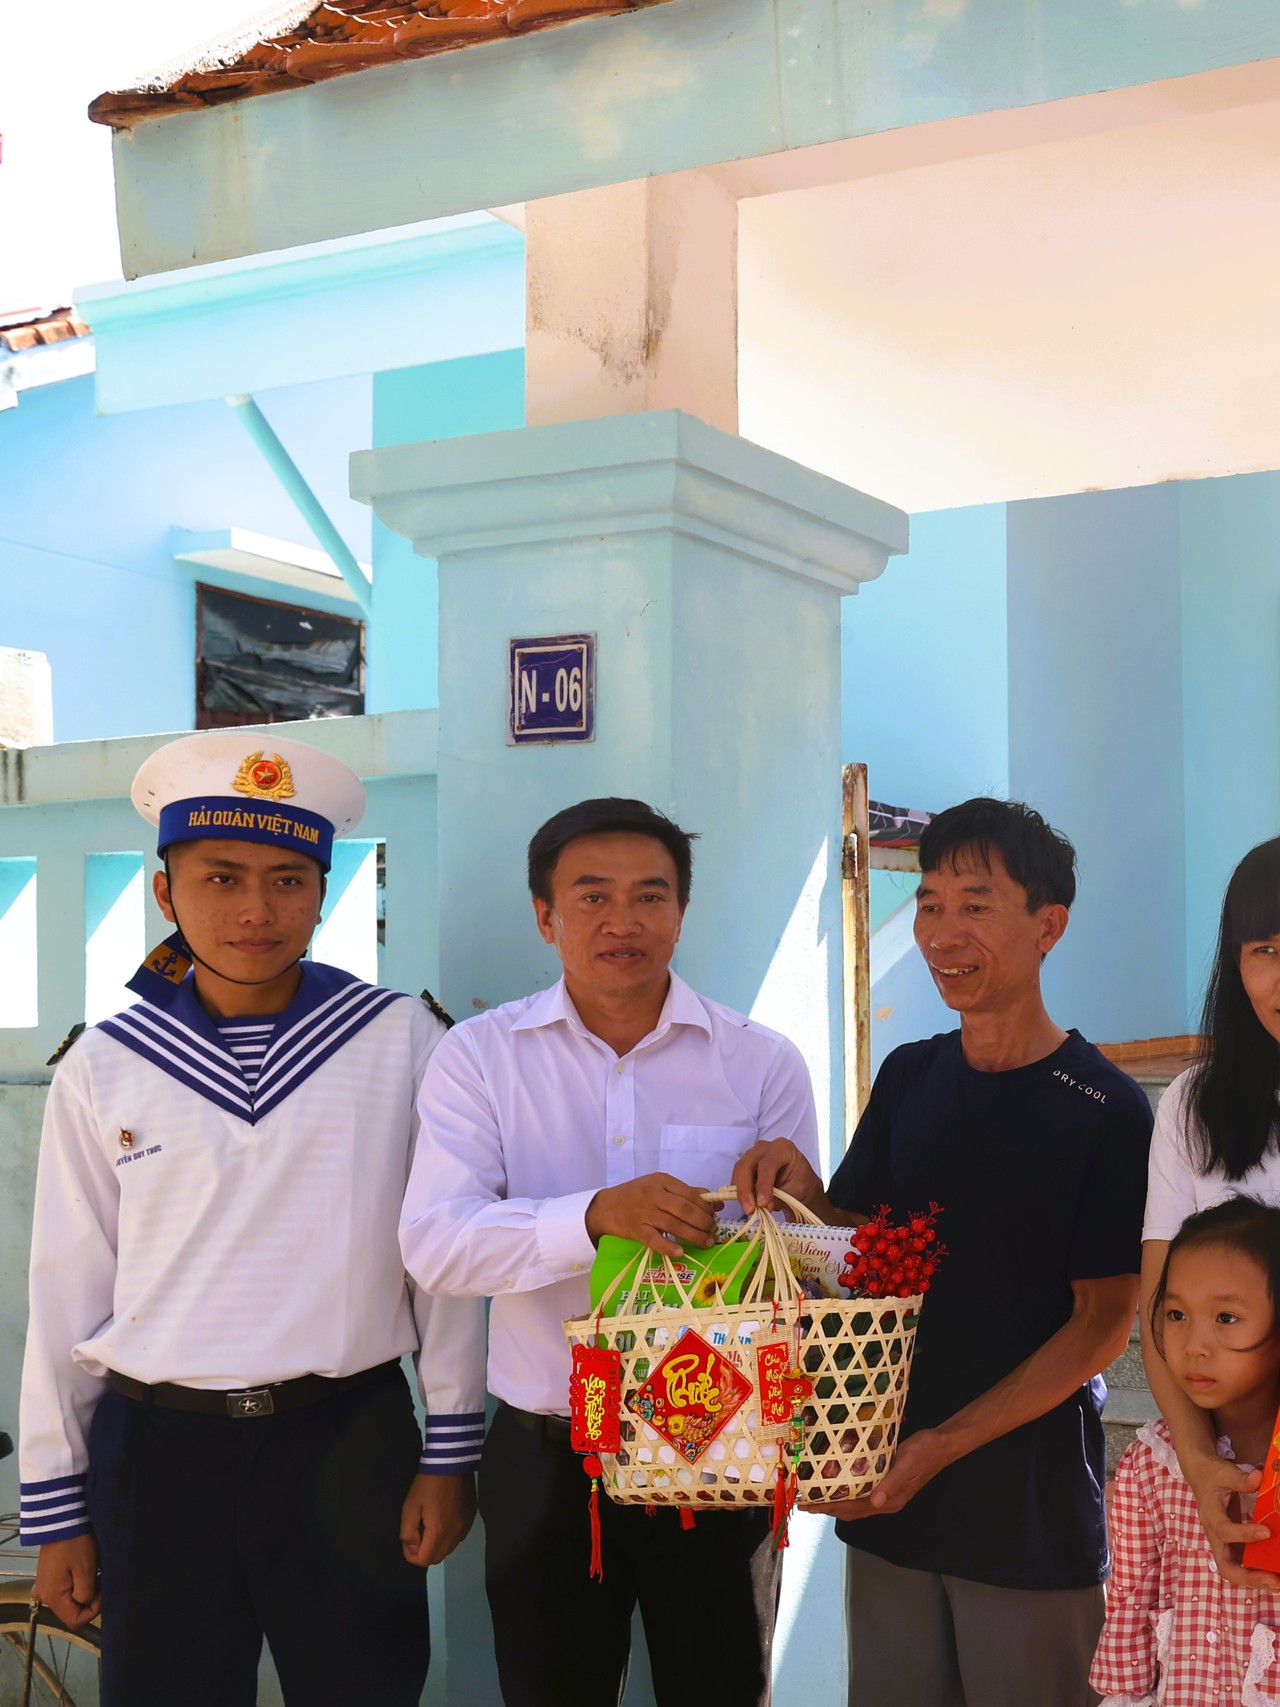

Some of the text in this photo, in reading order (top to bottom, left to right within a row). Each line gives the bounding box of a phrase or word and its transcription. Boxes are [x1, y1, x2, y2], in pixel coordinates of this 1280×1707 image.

[521, 669, 537, 714] N
[555, 666, 582, 712] 06
[188, 805, 320, 844] HẢI QUÂN VIỆT NAM
[1052, 1069, 1107, 1104] DRY COOL
